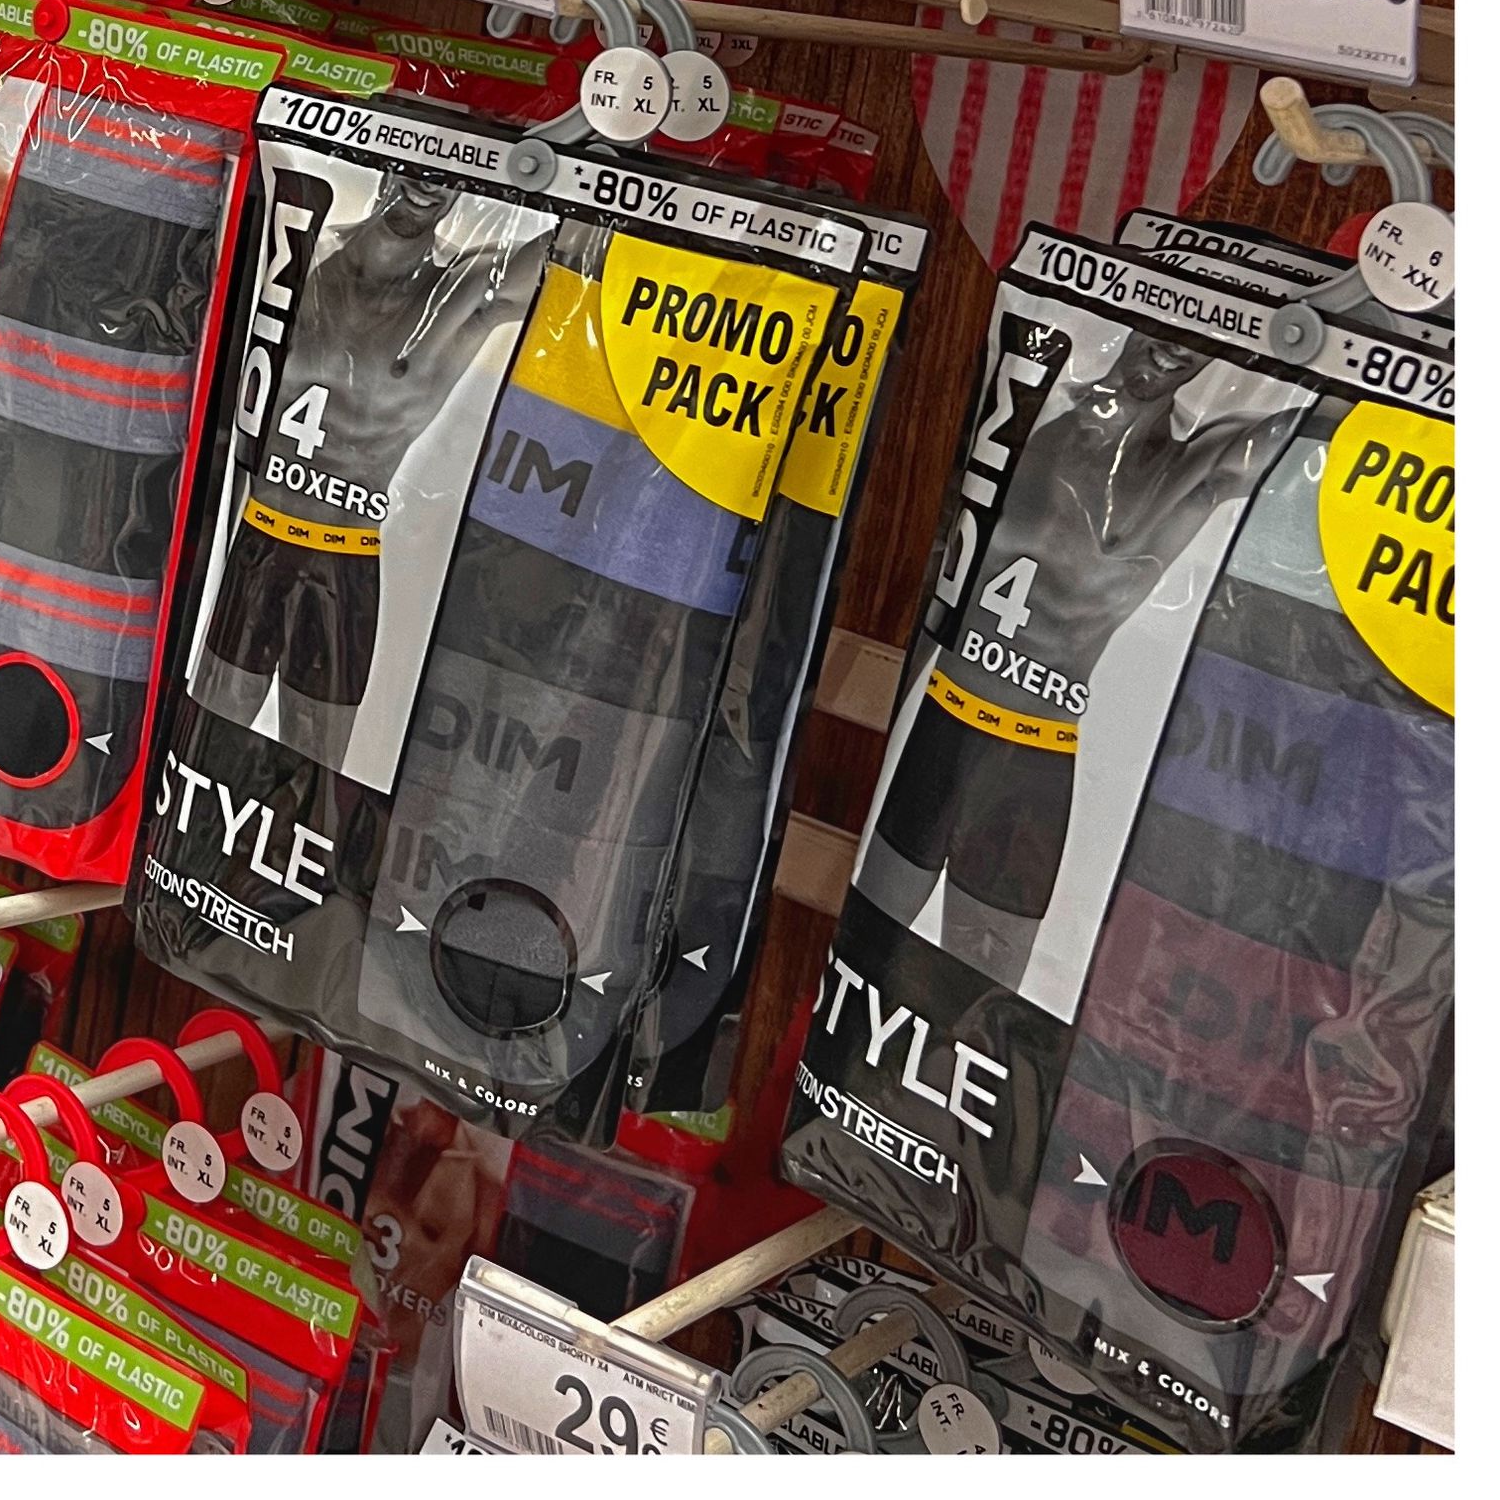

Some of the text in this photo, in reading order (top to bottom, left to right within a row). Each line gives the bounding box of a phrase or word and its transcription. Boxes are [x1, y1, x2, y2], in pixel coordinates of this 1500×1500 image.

[77, 18, 265, 81] -80% OF PLASTIC
[642, 74, 654, 92] 5
[633, 97, 657, 115] XL
[374, 125, 500, 171] RECYCLABLE
[690, 200, 724, 225] OF
[728, 211, 838, 255] PLASTIC
[1429, 250, 1444, 266] 6
[1132, 279, 1264, 340] RECYCLABLE
[1402, 264, 1442, 299] XXL
[235, 201, 316, 440] DIM
[620, 277, 794, 364] PROMO
[277, 385, 331, 461] 4
[641, 356, 775, 438] PACK
[265, 454, 390, 522] BOXERS
[978, 557, 1038, 640] 4
[960, 630, 1090, 715] BOXERS
[155, 749, 335, 906] STYLE
[424, 1059, 539, 1118] MIX COLORS
[235, 1256, 263, 1282] OF
[262, 1271, 342, 1324] PLASTIC
[77, 1335, 103, 1364] OF
[103, 1349, 186, 1412] PLASTIC
[558, 1342, 595, 1366] SHORTY
[623, 1372, 644, 1389] ATM
[1093, 1335, 1233, 1430] MIX COLORS
